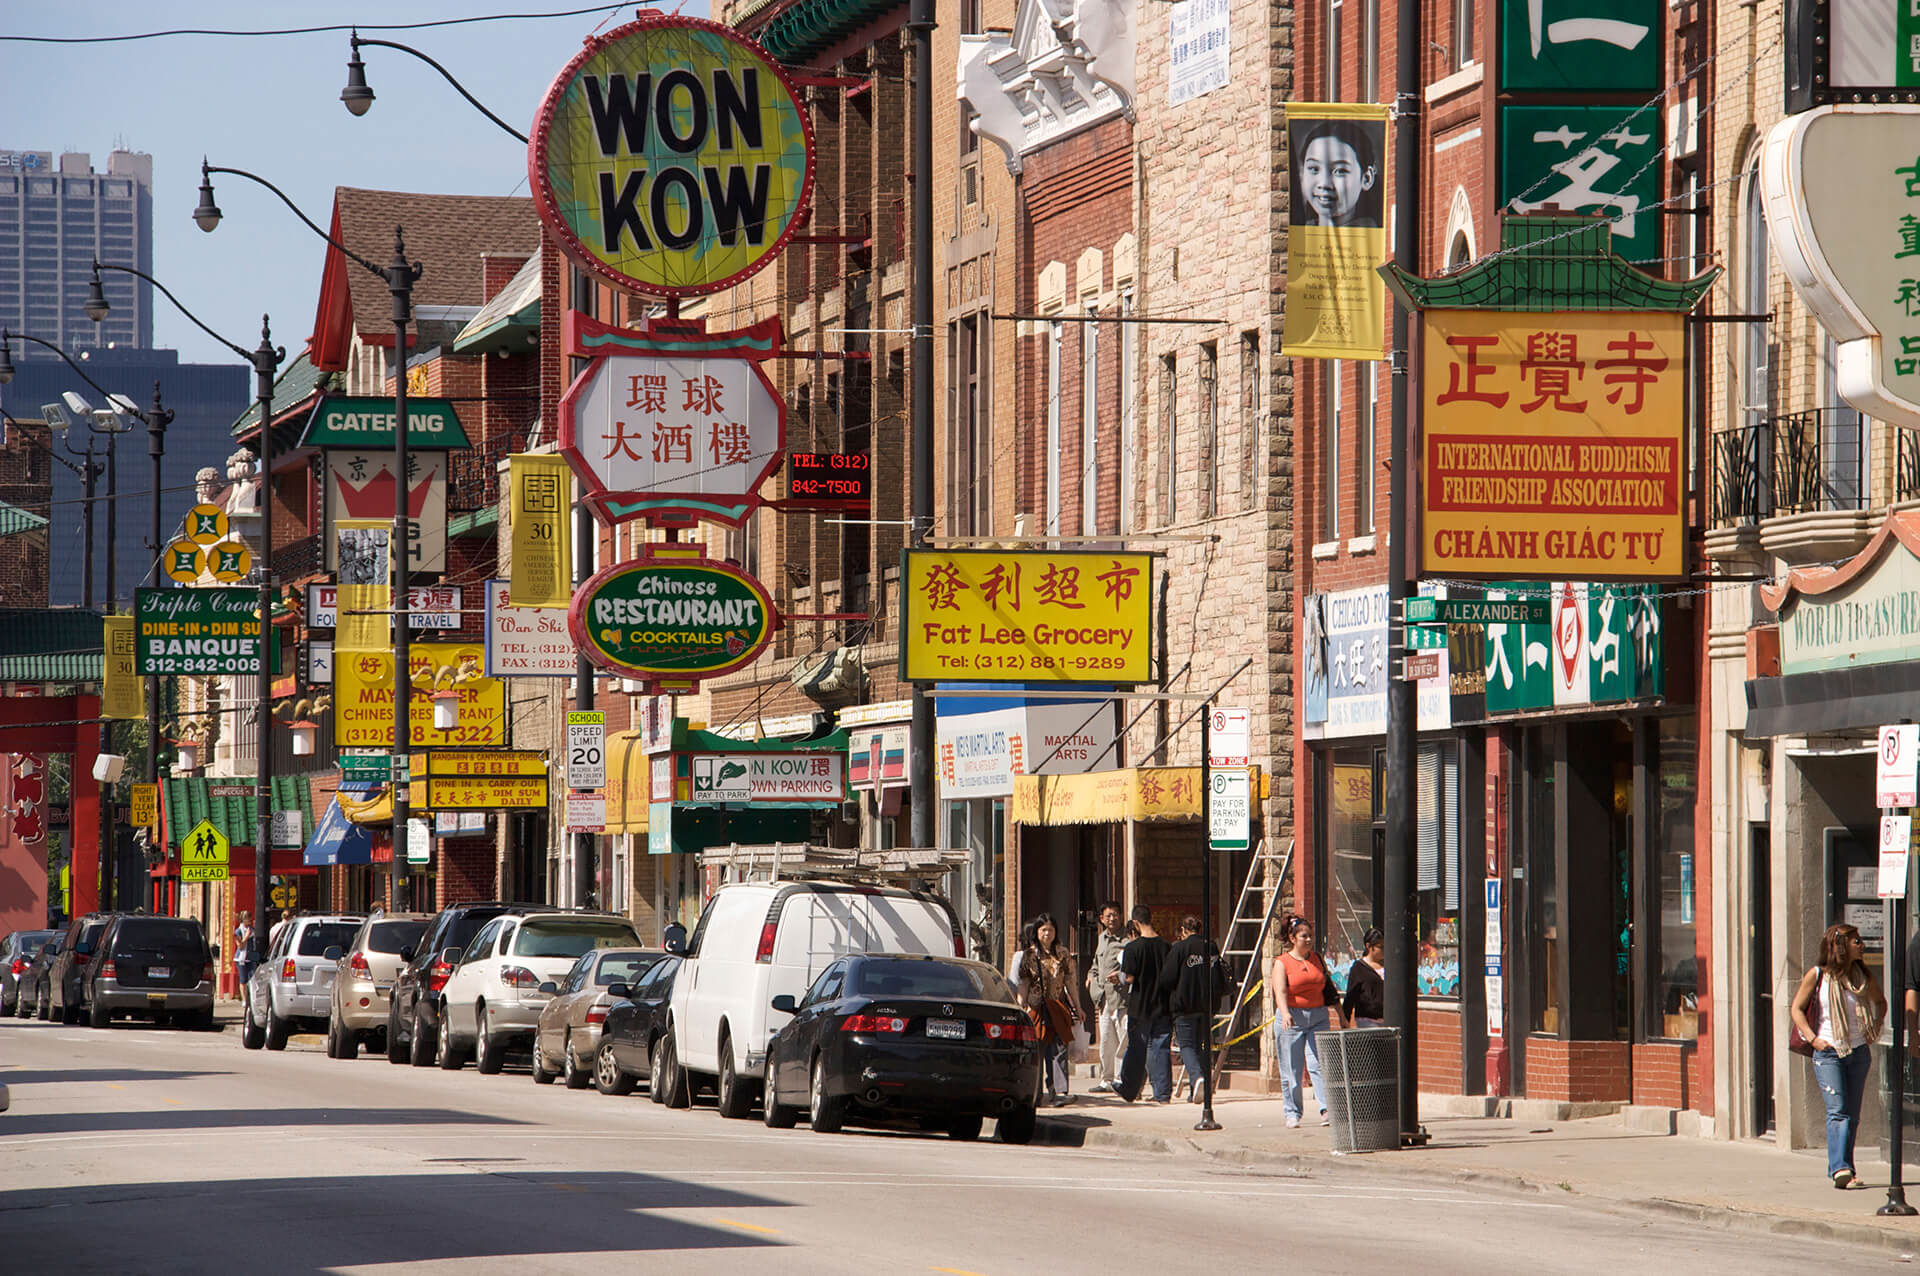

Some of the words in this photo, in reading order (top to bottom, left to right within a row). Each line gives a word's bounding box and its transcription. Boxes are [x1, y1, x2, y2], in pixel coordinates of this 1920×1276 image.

[583, 67, 763, 155] WON
[597, 163, 771, 253] KOW
[1437, 331, 1669, 415] 正覺寺
[626, 374, 724, 416] 環球
[327, 413, 444, 432] CATERNG
[601, 422, 751, 464] 大酒樓
[792, 453, 825, 468] TEL:
[830, 453, 868, 470] (312)
[1437, 442, 1574, 472] INTERNATIONAL
[1579, 446, 1671, 473] BUDDHISM
[792, 480, 861, 494] 842-7500
[1442, 477, 1547, 505] FRIENDSHIP
[1551, 479, 1665, 507] ASSOCIATION
[199, 517, 216, 533] 大
[530, 523, 552, 540] 30
[1434, 526, 1539, 559] CHÁNH
[1545, 527, 1616, 560] GIÁC
[177, 554, 192, 569] 三
[222, 554, 238, 571] 元
[638, 576, 717, 596] Chinese
[920, 561, 1140, 613] 發利超市
[142, 592, 200, 620] Triple
[209, 591, 260, 613] Crow
[594, 598, 758, 627] RESTAURANT
[1333, 594, 1370, 629] CHICAGO
[1373, 591, 1390, 623] FOO
[1443, 604, 1529, 621] ALEXANDER
[1533, 608, 1543, 618] ST
[142, 622, 200, 635] DINE-IN
[211, 623, 239, 635] DIM
[241, 623, 260, 635] SU
[411, 615, 453, 627] TRAVEL
[496, 617, 533, 632] Wan
[537, 616, 565, 633] Shi
[1794, 603, 1843, 650] WORLD
[1845, 590, 1920, 642] TREASURE
[630, 631, 723, 645] COCKTAILS
[923, 623, 971, 645] Fat
[980, 624, 1026, 645] Lee
[1033, 624, 1133, 650] Grocery
[150, 639, 260, 656] BANQUE
[539, 644, 570, 655] (312)
[145, 659, 260, 672] 312-842-008
[539, 658, 570, 669] (312)
[938, 656, 969, 668] Tel:
[974, 654, 1025, 670] (312)
[1030, 656, 1126, 671] 881-9289
[344, 708, 393, 721] CHINES
[411, 708, 494, 720] RESRANT
[570, 714, 602, 722] SCHOOL
[346, 729, 384, 742] (312)
[571, 727, 601, 736] SPEED
[574, 737, 598, 746] LIMIT
[1044, 735, 1097, 746] MARTIAL
[572, 748, 600, 765] 20
[1055, 749, 1088, 760] ARTS
[772, 760, 808, 775] KOW
[727, 791, 748, 799] PARK
[781, 780, 833, 793] PARKING
[1139, 776, 1193, 806] 發利
[1212, 800, 1226, 808] PAY
[1229, 800, 1244, 808] FOR
[1212, 809, 1246, 817] PARKING
[187, 868, 223, 878] AHEAD
